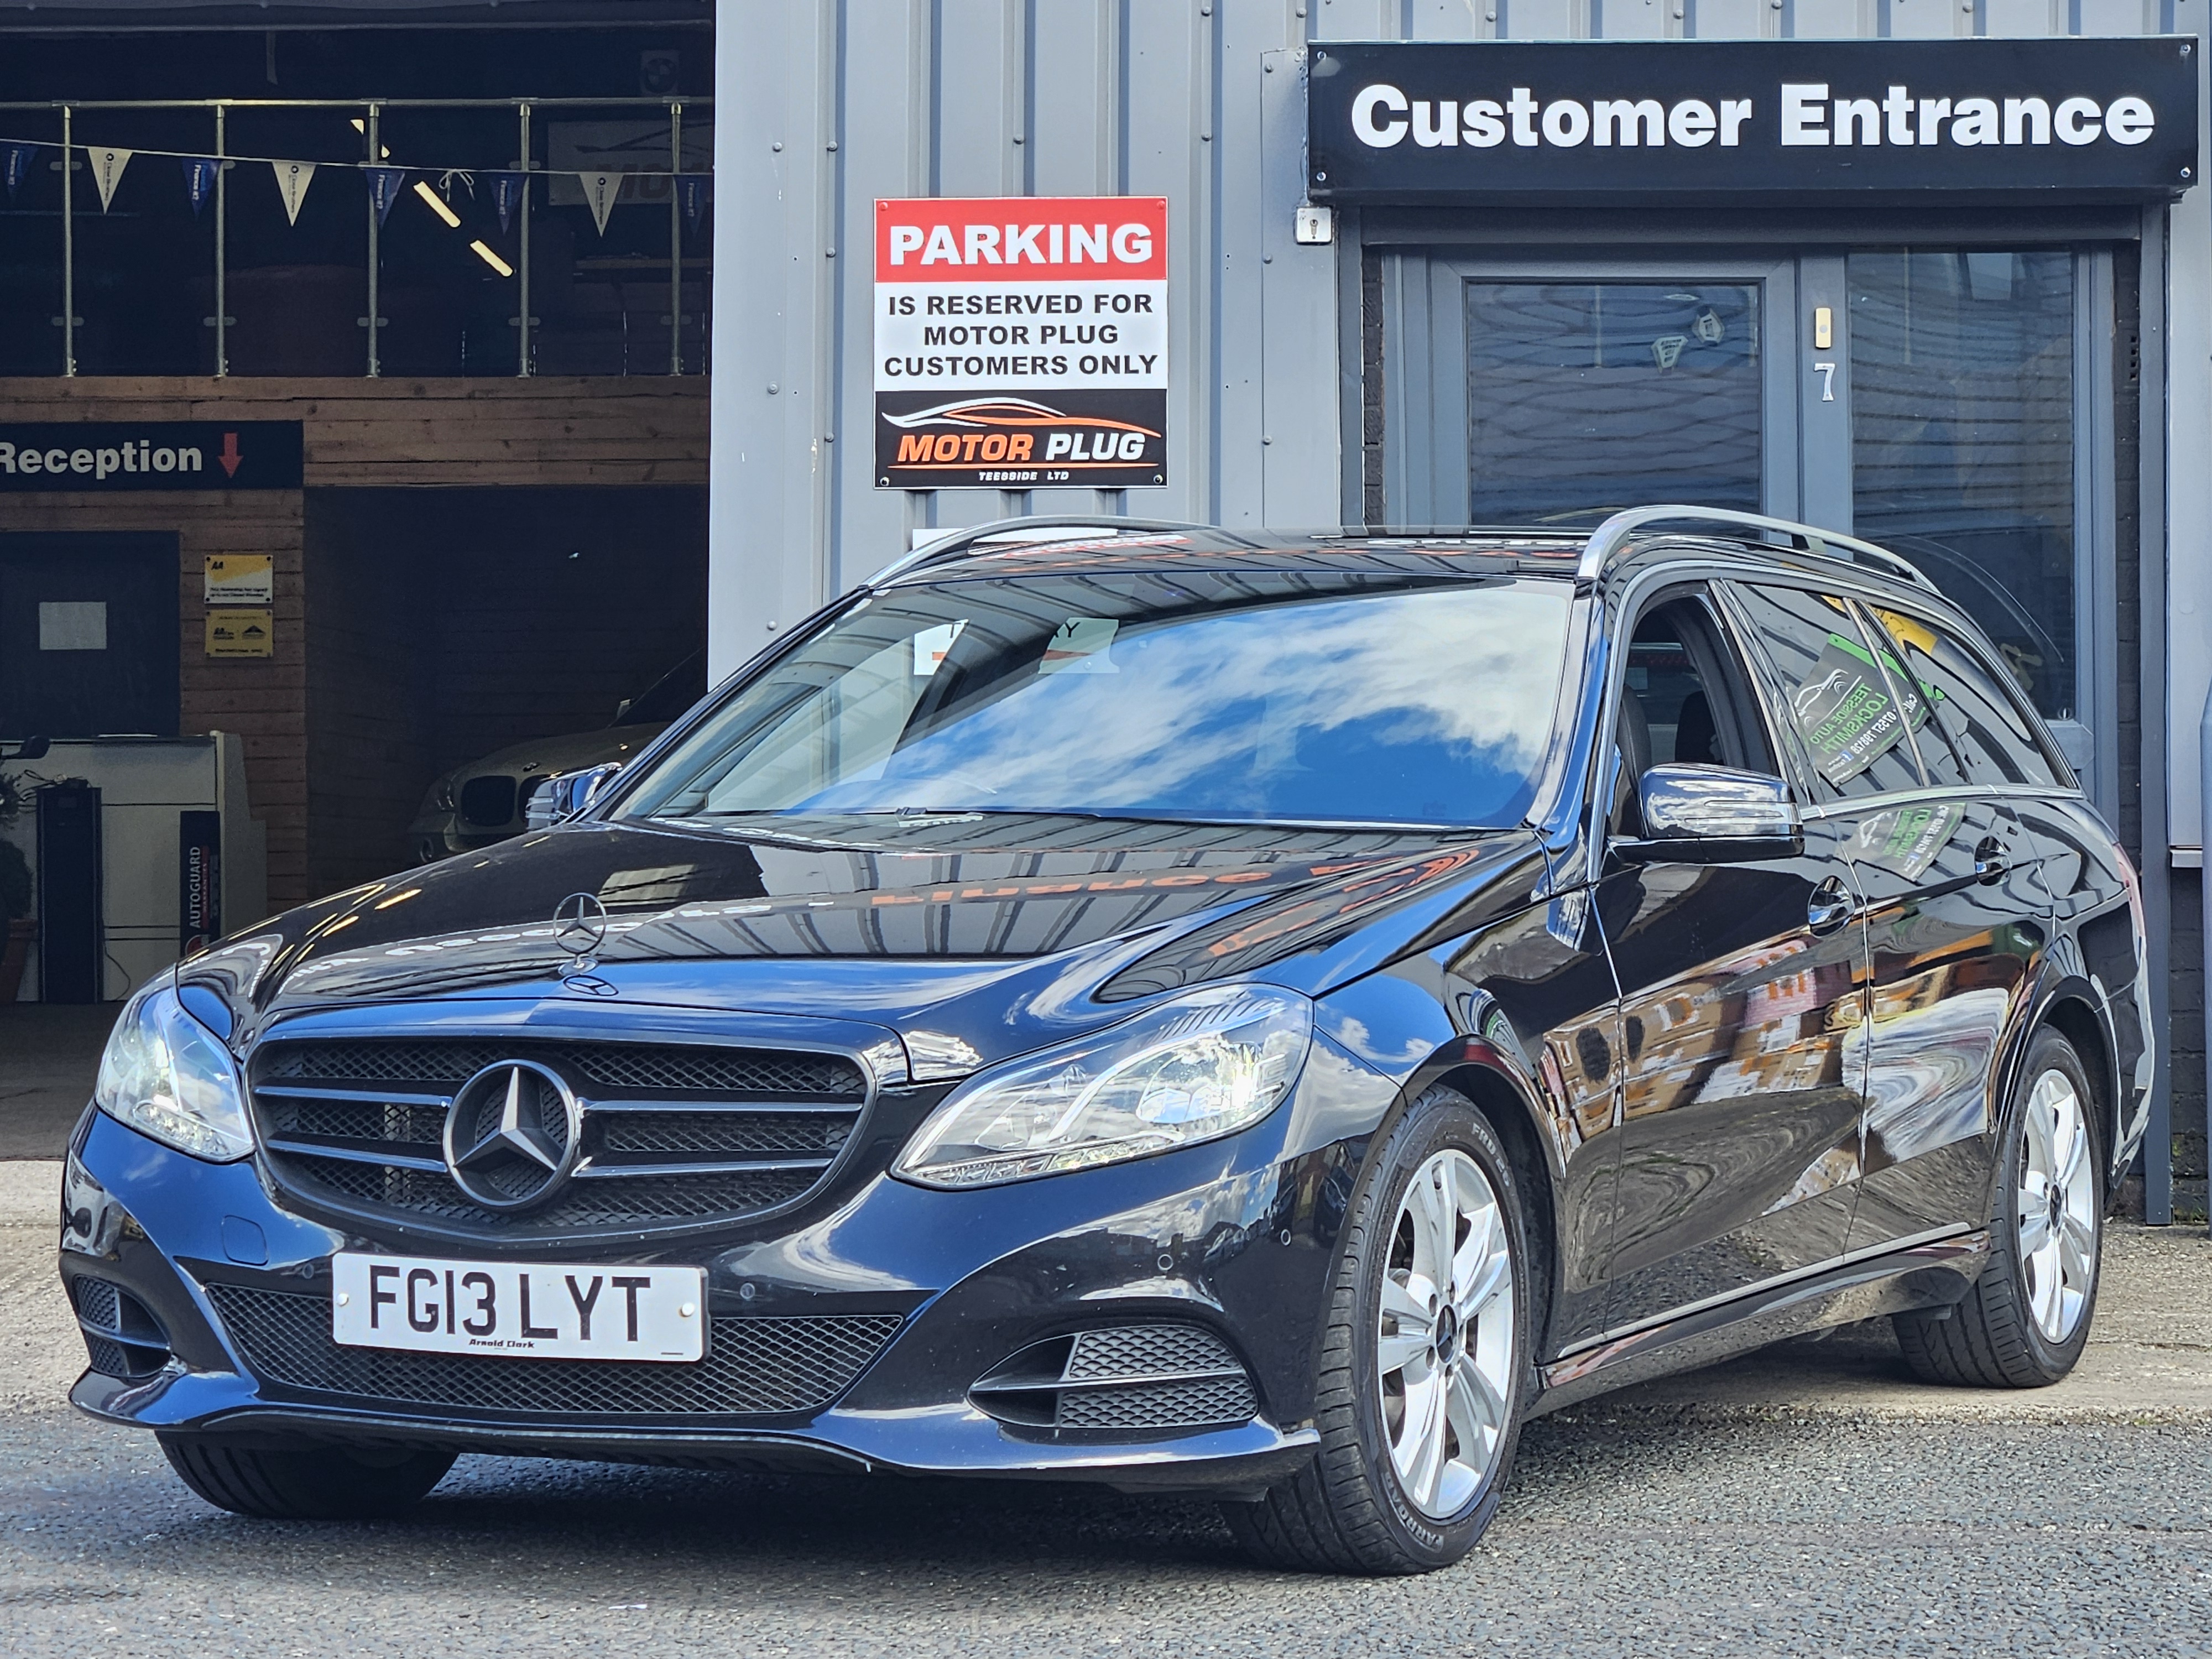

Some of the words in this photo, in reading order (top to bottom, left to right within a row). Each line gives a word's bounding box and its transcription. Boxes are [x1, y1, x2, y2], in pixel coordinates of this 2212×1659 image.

[1351, 83, 1752, 148] Customer
[1781, 83, 2156, 147] Entrance
[889, 223, 1152, 265] PARKING
[889, 296, 916, 316] IS
[927, 295, 1083, 316] RESERVED
[1094, 294, 1153, 314] FOR
[924, 326, 1030, 346] MOTOR
[1040, 325, 1119, 345] PLUG
[884, 356, 1068, 377] CUSTOMERS
[1079, 354, 1158, 375] ONLY
[1813, 363, 1836, 403] 7
[0, 440, 202, 480] Reception
[897, 433, 1034, 462] MOTOR
[1045, 433, 1145, 461] PLUG
[978, 471, 1037, 481] TEESSIDE
[1047, 470, 1070, 481] LTD
[189, 846, 201, 928] AUTOGUARD
[1471, 1122, 1496, 1155] FRD
[369, 1264, 497, 1337] FG13
[519, 1273, 651, 1342] LYT
[469, 1339, 504, 1347] Arnold
